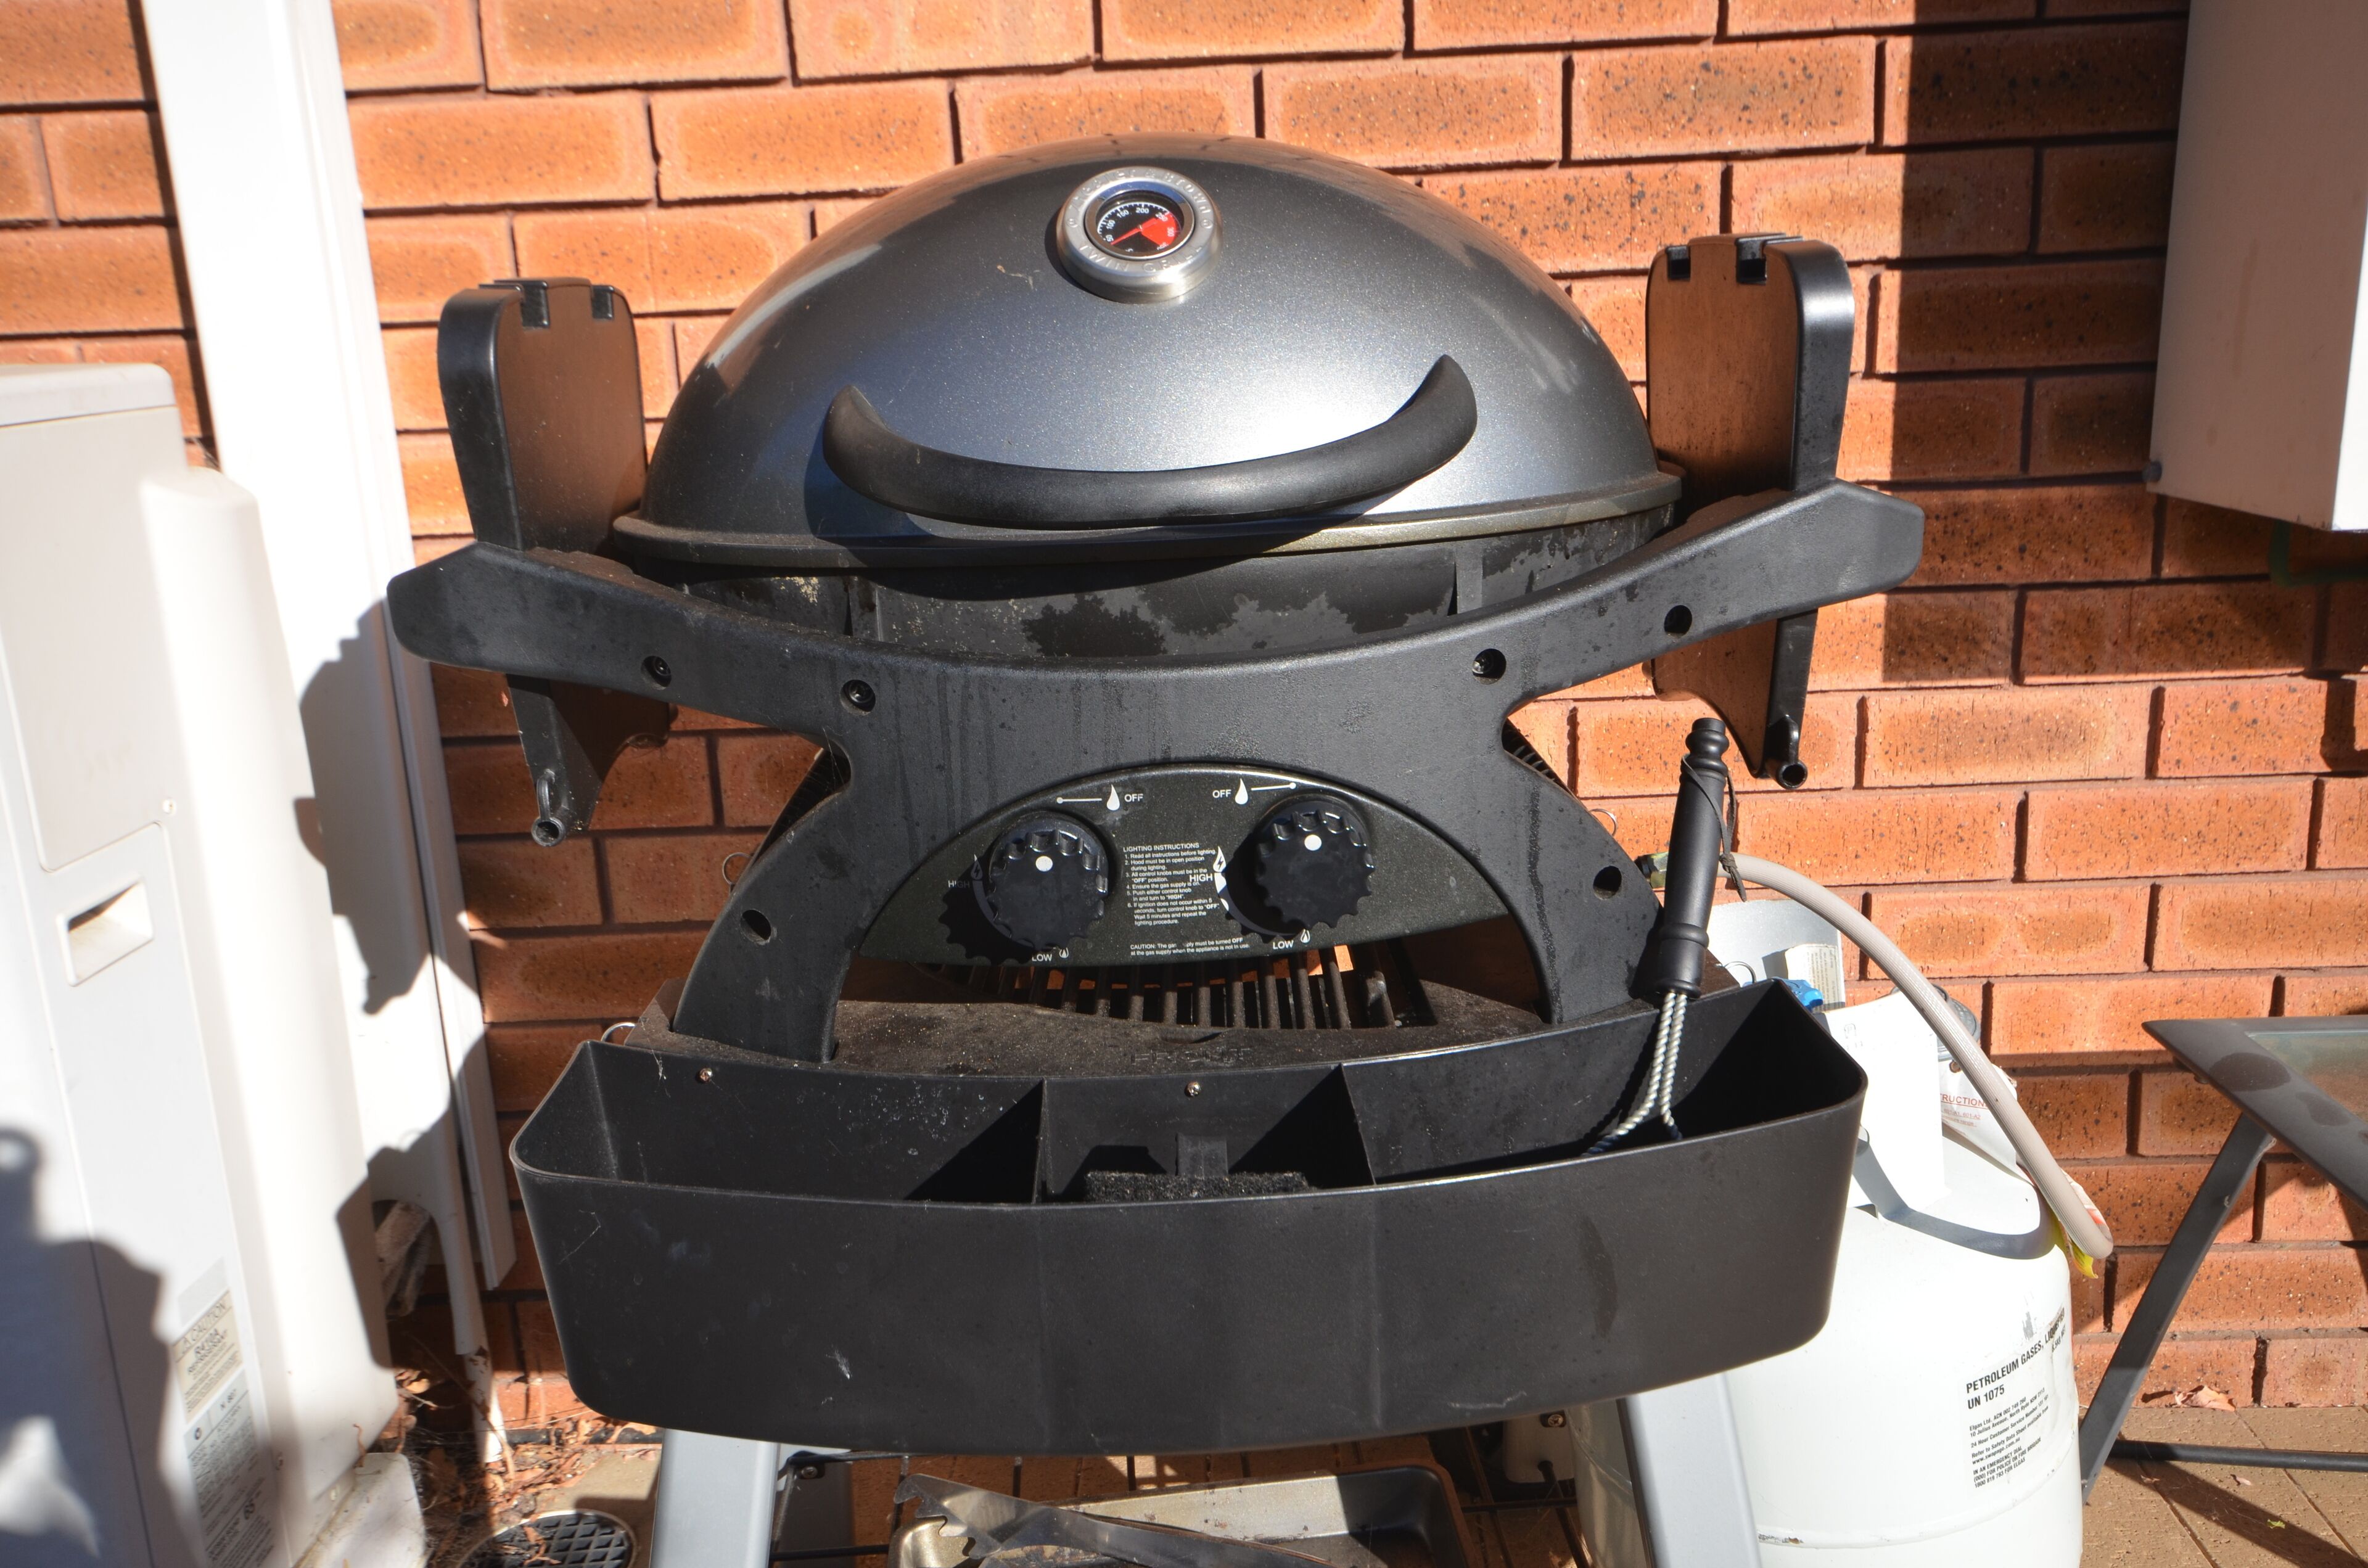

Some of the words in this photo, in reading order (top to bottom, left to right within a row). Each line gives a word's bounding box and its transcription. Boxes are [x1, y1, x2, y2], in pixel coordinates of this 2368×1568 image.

[1106, 219, 1116, 230] 100
[1116, 210, 1130, 219] 150
[1080, 245, 1129, 272] TWIN
[1124, 794, 1143, 802] OFF
[1212, 789, 1231, 798] OFF
[1154, 843, 1199, 851] INSTRUCTIONS
[948, 880, 970, 889] HIGH
[1189, 873, 1213, 882] HIGH
[1273, 940, 1294, 950] LOW
[1032, 954, 1052, 962] LOW
[191, 1302, 226, 1342] CAUTION
[1966, 1358, 2019, 1394] PETROLEUM
[2021, 1340, 2044, 1365] GASES,
[1967, 1395, 1981, 1410] UN
[1984, 1384, 2005, 1403] 1075
[1970, 1423, 1983, 1432] Elgas
[1994, 1413, 2002, 1421] ACN
[1977, 1426, 1991, 1435] Julius
[2010, 1408, 2020, 1418] North
[2021, 1402, 2029, 1411] Ryde
[1978, 1437, 1989, 1445] Hour
[1990, 1427, 2010, 1440] Customer
[2010, 1417, 2025, 1429] Service
[2025, 1406, 2037, 1418] Number
[1971, 1451, 1984, 1459] Refer
[1991, 1439, 2005, 1450] Safety
[2006, 1434, 2015, 1442] Data
[2016, 1426, 2027, 1437] Sheet
[2028, 1413, 2042, 1427] available
[1987, 1453, 2013, 1469] EMERGENCY
[2014, 1446, 2022, 1455] DIAL
[1997, 1459, 2012, 1472] POLICE
[2018, 1450, 2026, 1459] FIRE
[1975, 1480, 1986, 1488] 1800
[2005, 1466, 2013, 1474] FOR
[2014, 1457, 2026, 1468] ELGAS
